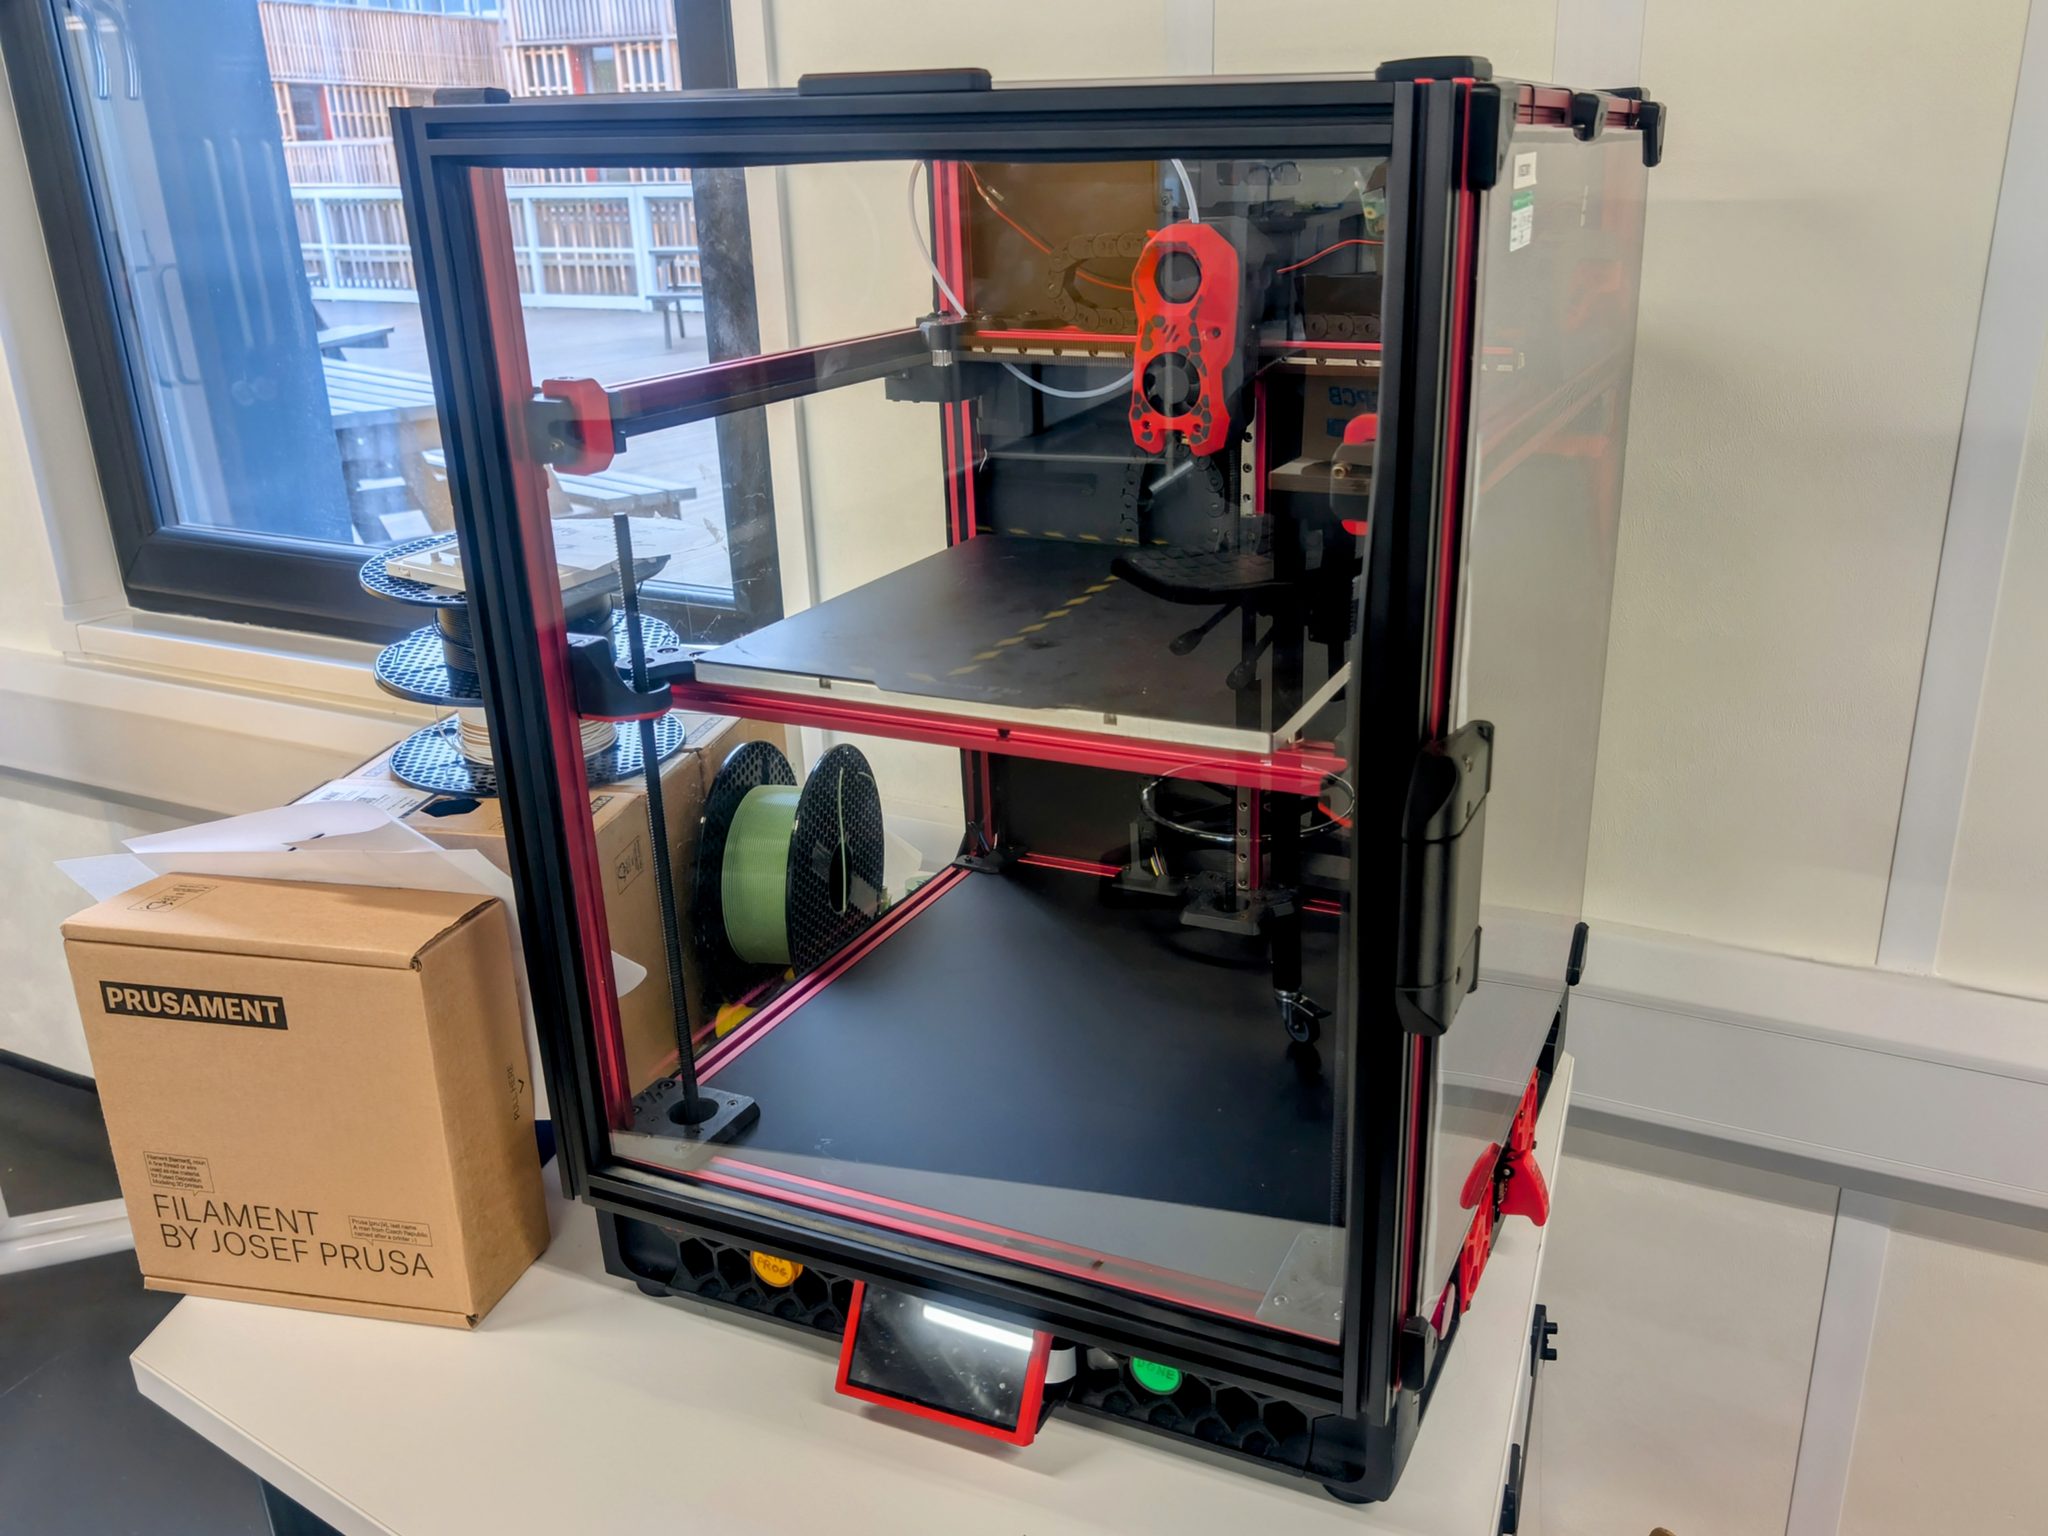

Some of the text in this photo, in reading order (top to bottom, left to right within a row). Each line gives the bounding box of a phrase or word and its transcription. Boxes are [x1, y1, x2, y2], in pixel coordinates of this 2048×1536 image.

[106, 986, 279, 1024] PRUSAMENT
[153, 1194, 319, 1236] FILAMENT
[160, 1223, 434, 1279] BY JOSEF PRUSA
